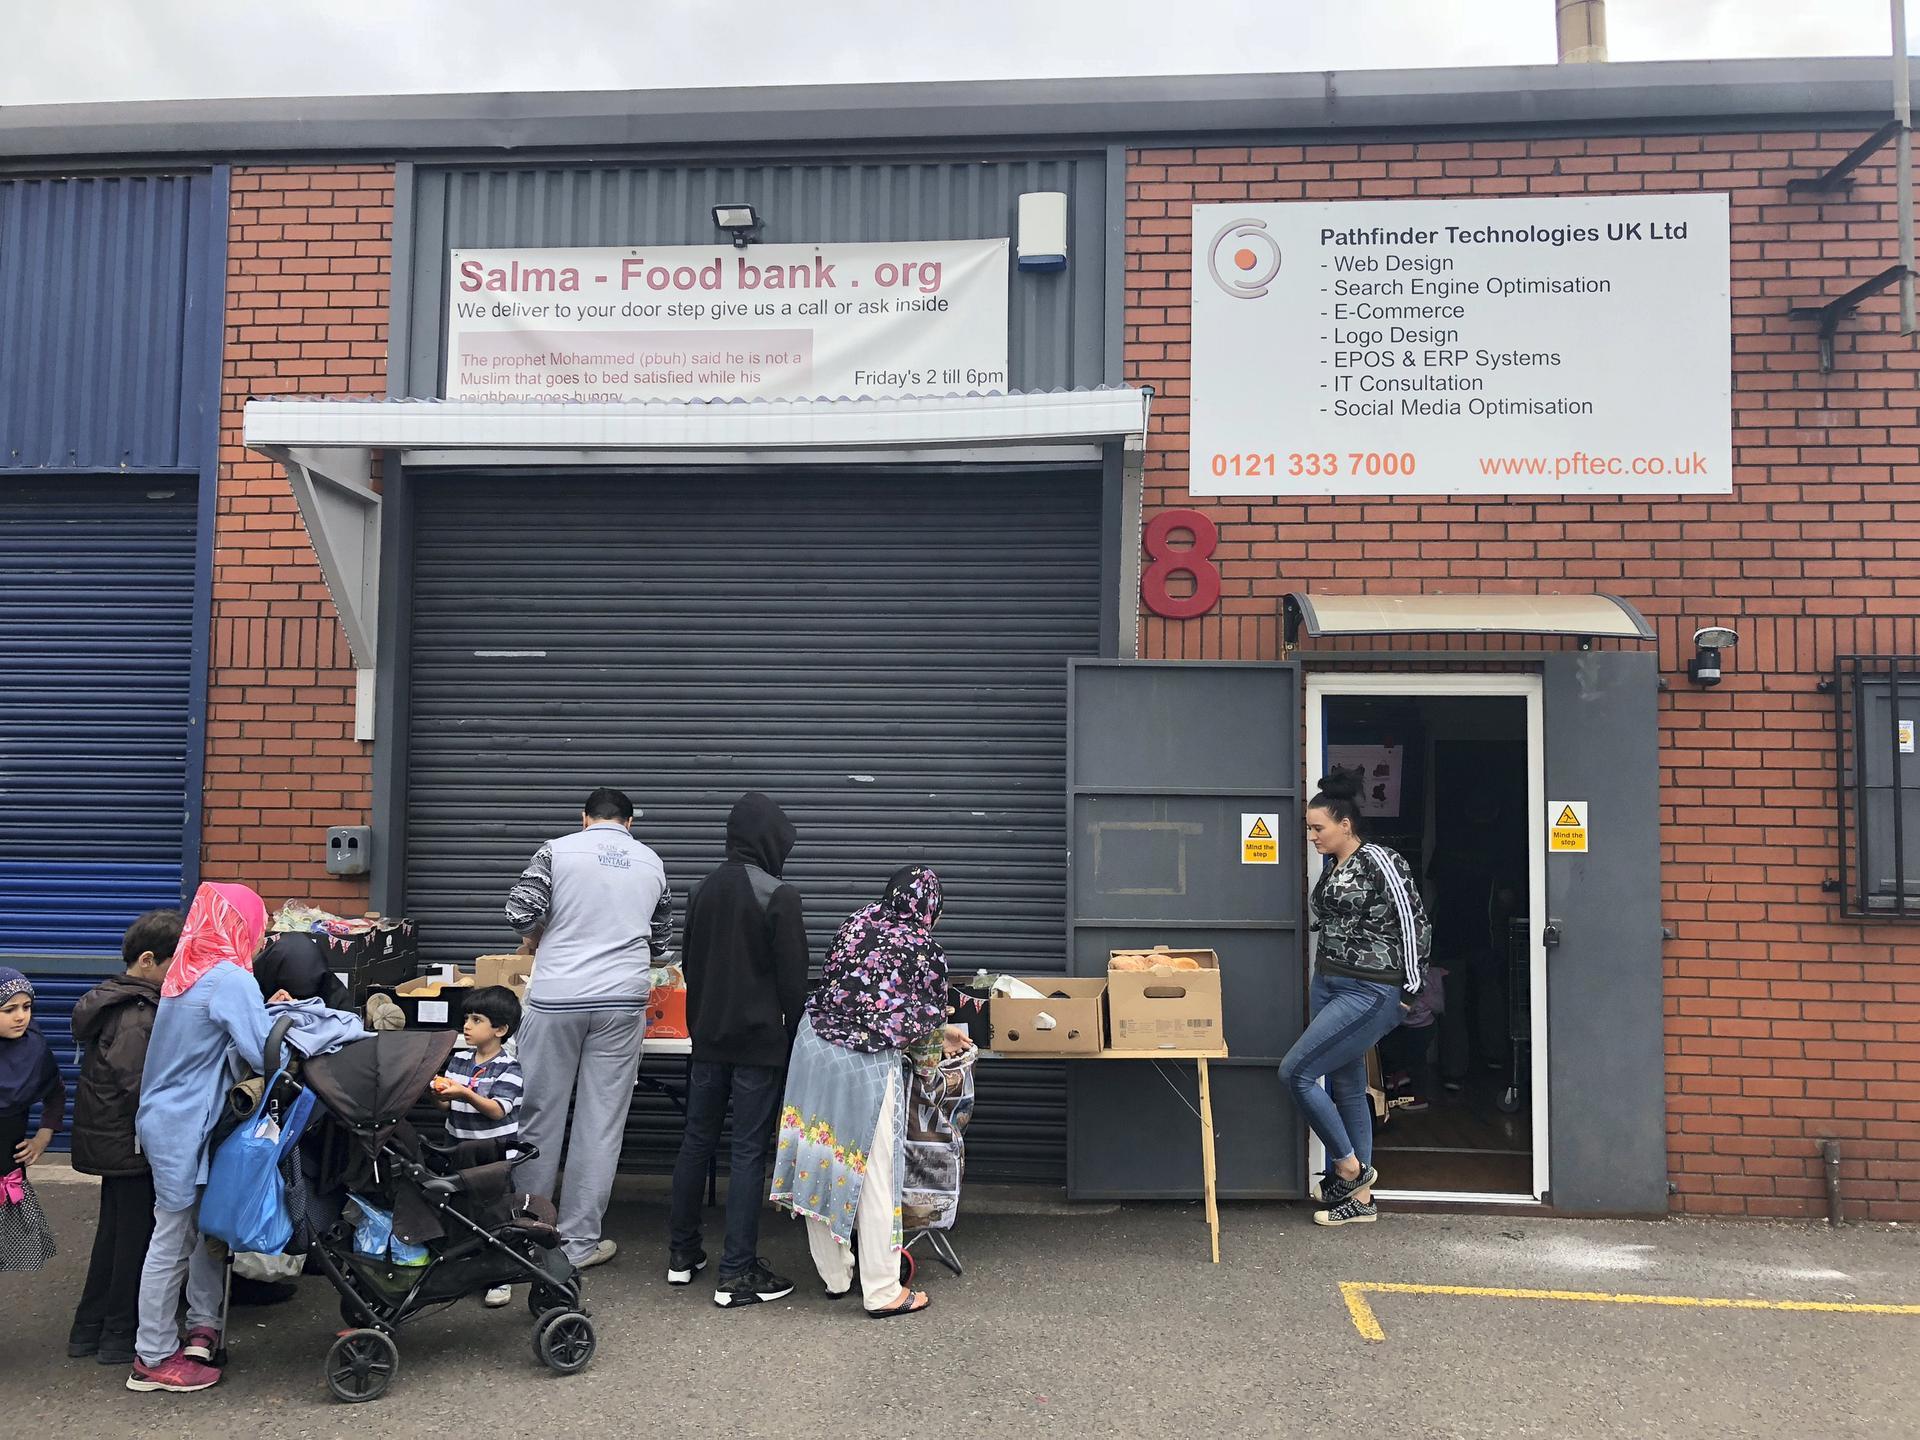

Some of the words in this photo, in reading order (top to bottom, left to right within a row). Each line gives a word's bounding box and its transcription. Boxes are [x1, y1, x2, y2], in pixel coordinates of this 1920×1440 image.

[1322, 227, 1438, 245] Pathfinder
[1445, 225, 1599, 246] Technologies
[1608, 223, 1641, 240] UK
[1651, 222, 1686, 239] Ltd
[460, 261, 579, 292] Salma
[622, 257, 721, 290] Food
[738, 256, 836, 289] bank
[875, 260, 941, 293] org
[1335, 256, 1378, 271] Web
[1387, 255, 1453, 274] Design
[1335, 279, 1402, 295] Search
[1412, 279, 1479, 298] Engine
[1487, 277, 1610, 297] Optimisation
[458, 303, 485, 318] We
[492, 302, 549, 317] deliver
[555, 304, 570, 317] to
[578, 306, 616, 321] your
[622, 302, 661, 316] door
[668, 303, 704, 320] step
[712, 301, 747, 320] give
[755, 304, 774, 315] us
[782, 304, 791, 315] a
[799, 300, 827, 314] call
[835, 303, 852, 314] or
[859, 299, 889, 314] ask
[897, 296, 948, 311] inside
[1336, 303, 1464, 319] E-Commerce
[1335, 328, 1382, 347] Logo
[1391, 327, 1457, 346] Design
[461, 354, 487, 366] The
[493, 352, 547, 369] prophet
[550, 352, 634, 365] Mohammed
[640, 352, 686, 369] (pbuh)
[692, 352, 720, 364] said
[727, 352, 743, 364] he
[749, 352, 760, 364] is
[766, 352, 787, 364] not
[793, 354, 801, 363] a
[1336, 351, 1394, 367] EPOS
[1403, 351, 1416, 367] &
[1425, 350, 1468, 366] ERP
[1476, 350, 1560, 370] Systems
[461, 371, 509, 384] Muslim
[516, 371, 541, 384] that
[546, 374, 579, 387] goes
[584, 372, 597, 383] to
[603, 371, 628, 383] bed
[634, 369, 692, 383] satisfied
[698, 371, 735, 383] while
[741, 370, 760, 382] his
[856, 370, 920, 388] Friday's
[927, 370, 936, 384] 2
[943, 369, 959, 383] till
[967, 369, 1003, 386] 6pm
[1336, 376, 1353, 391] IT
[1360, 375, 1482, 391] Consultation
[1335, 400, 1393, 416] Social
[1402, 399, 1460, 415] Media
[1469, 398, 1592, 418] Optimisation
[1212, 454, 1274, 476] 0121
[1289, 453, 1337, 476] 333
[1349, 453, 1415, 475] 7000
[1480, 452, 1707, 480] www.pftec.co.uk
[1142, 509, 1220, 619] 8
[1554, 831, 1570, 839] Mind
[1572, 831, 1582, 839] the
[598, 855, 631, 867] VINTAGE
